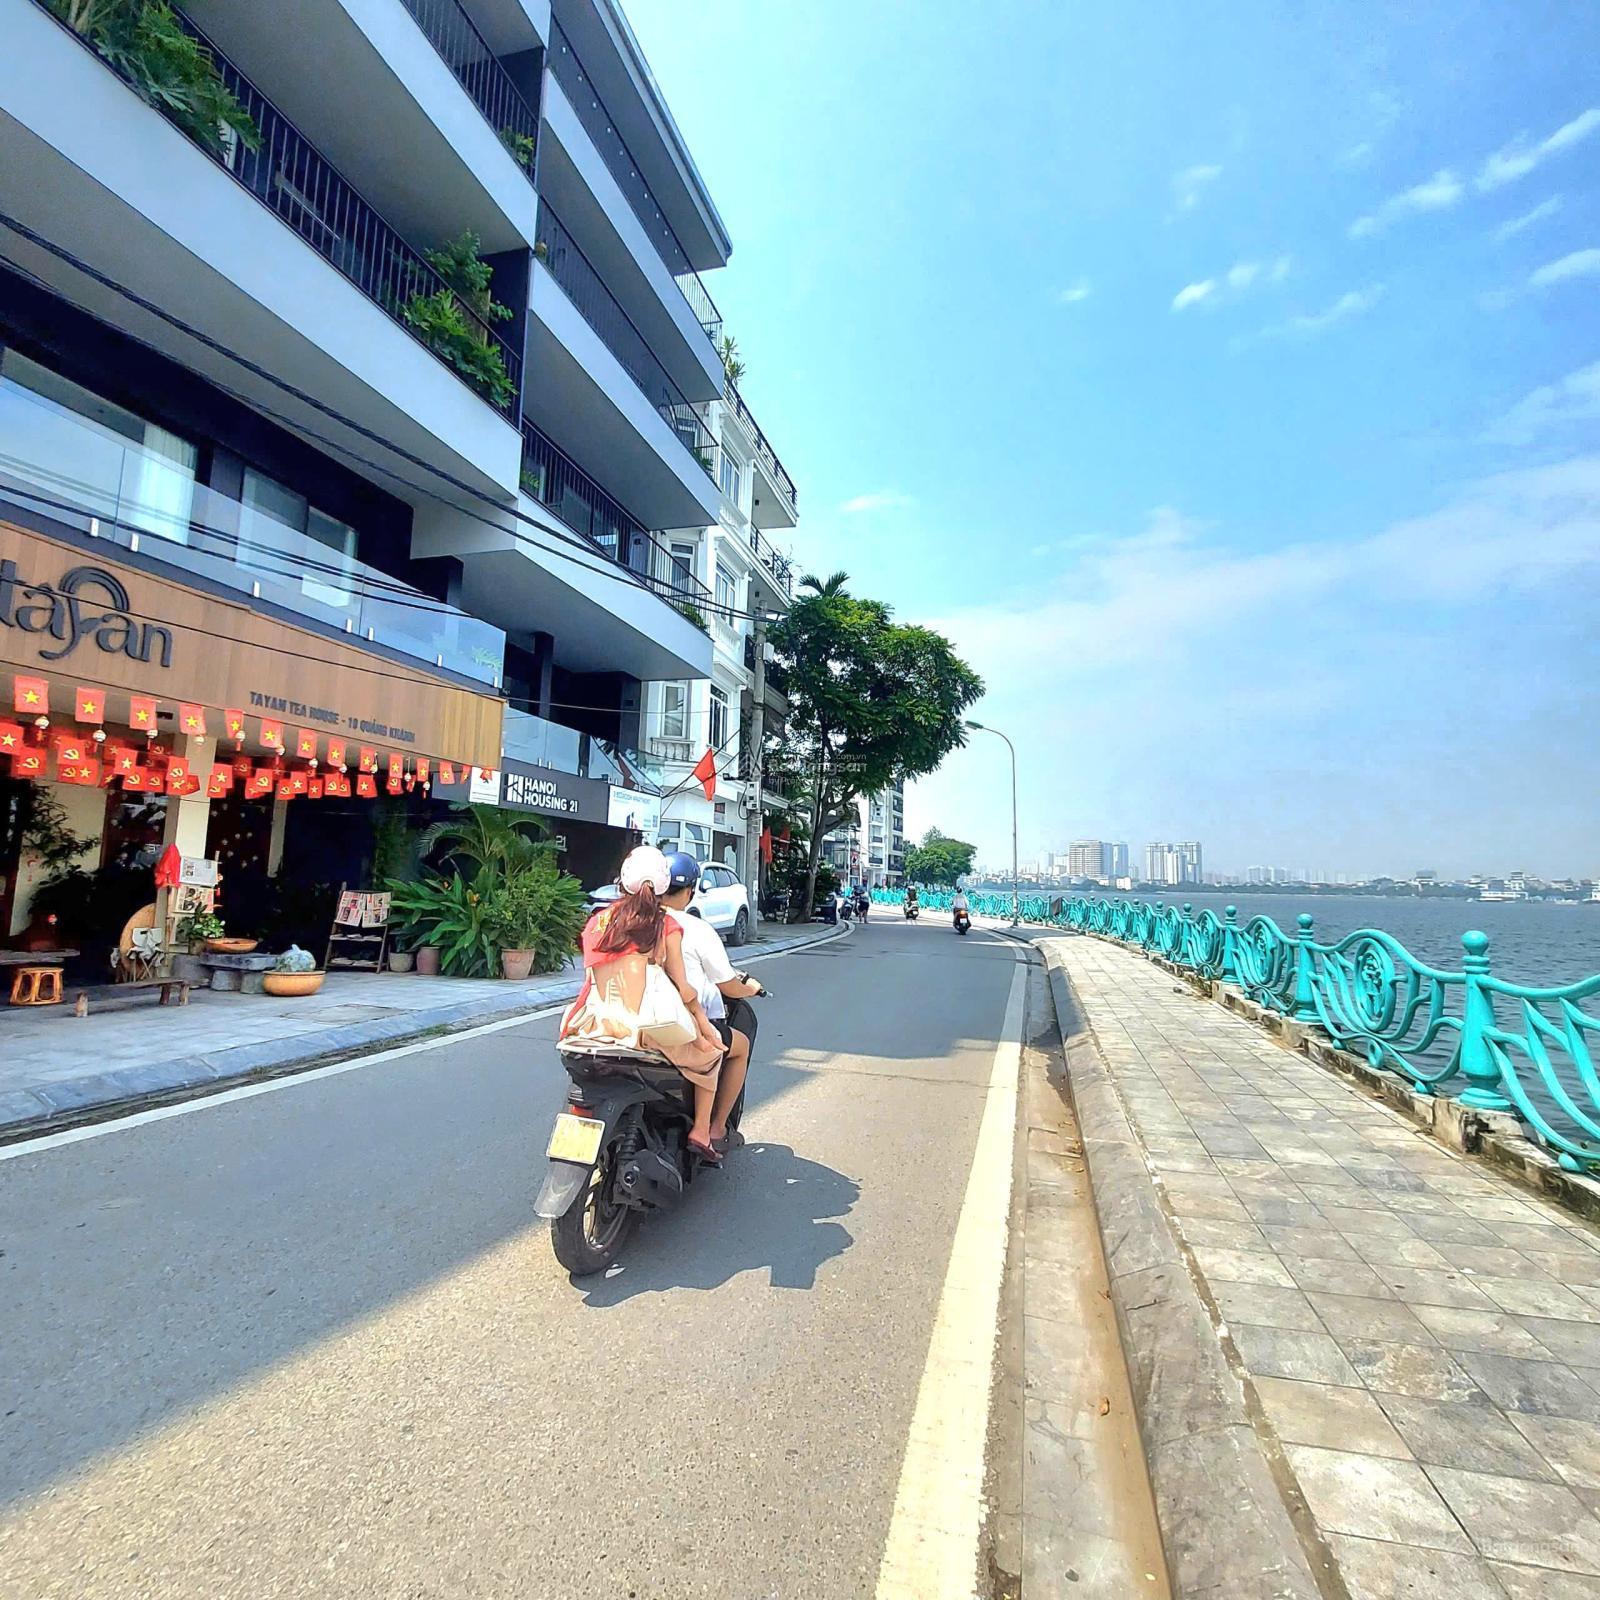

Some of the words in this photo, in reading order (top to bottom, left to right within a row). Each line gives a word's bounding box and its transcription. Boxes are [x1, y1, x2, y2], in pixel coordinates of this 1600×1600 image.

[289, 701, 306, 717] TEA
[524, 777, 557, 796] HANOI
[523, 793, 567, 811] HOUSING
[569, 799, 579, 813] 21
[555, 835, 566, 848] 21
